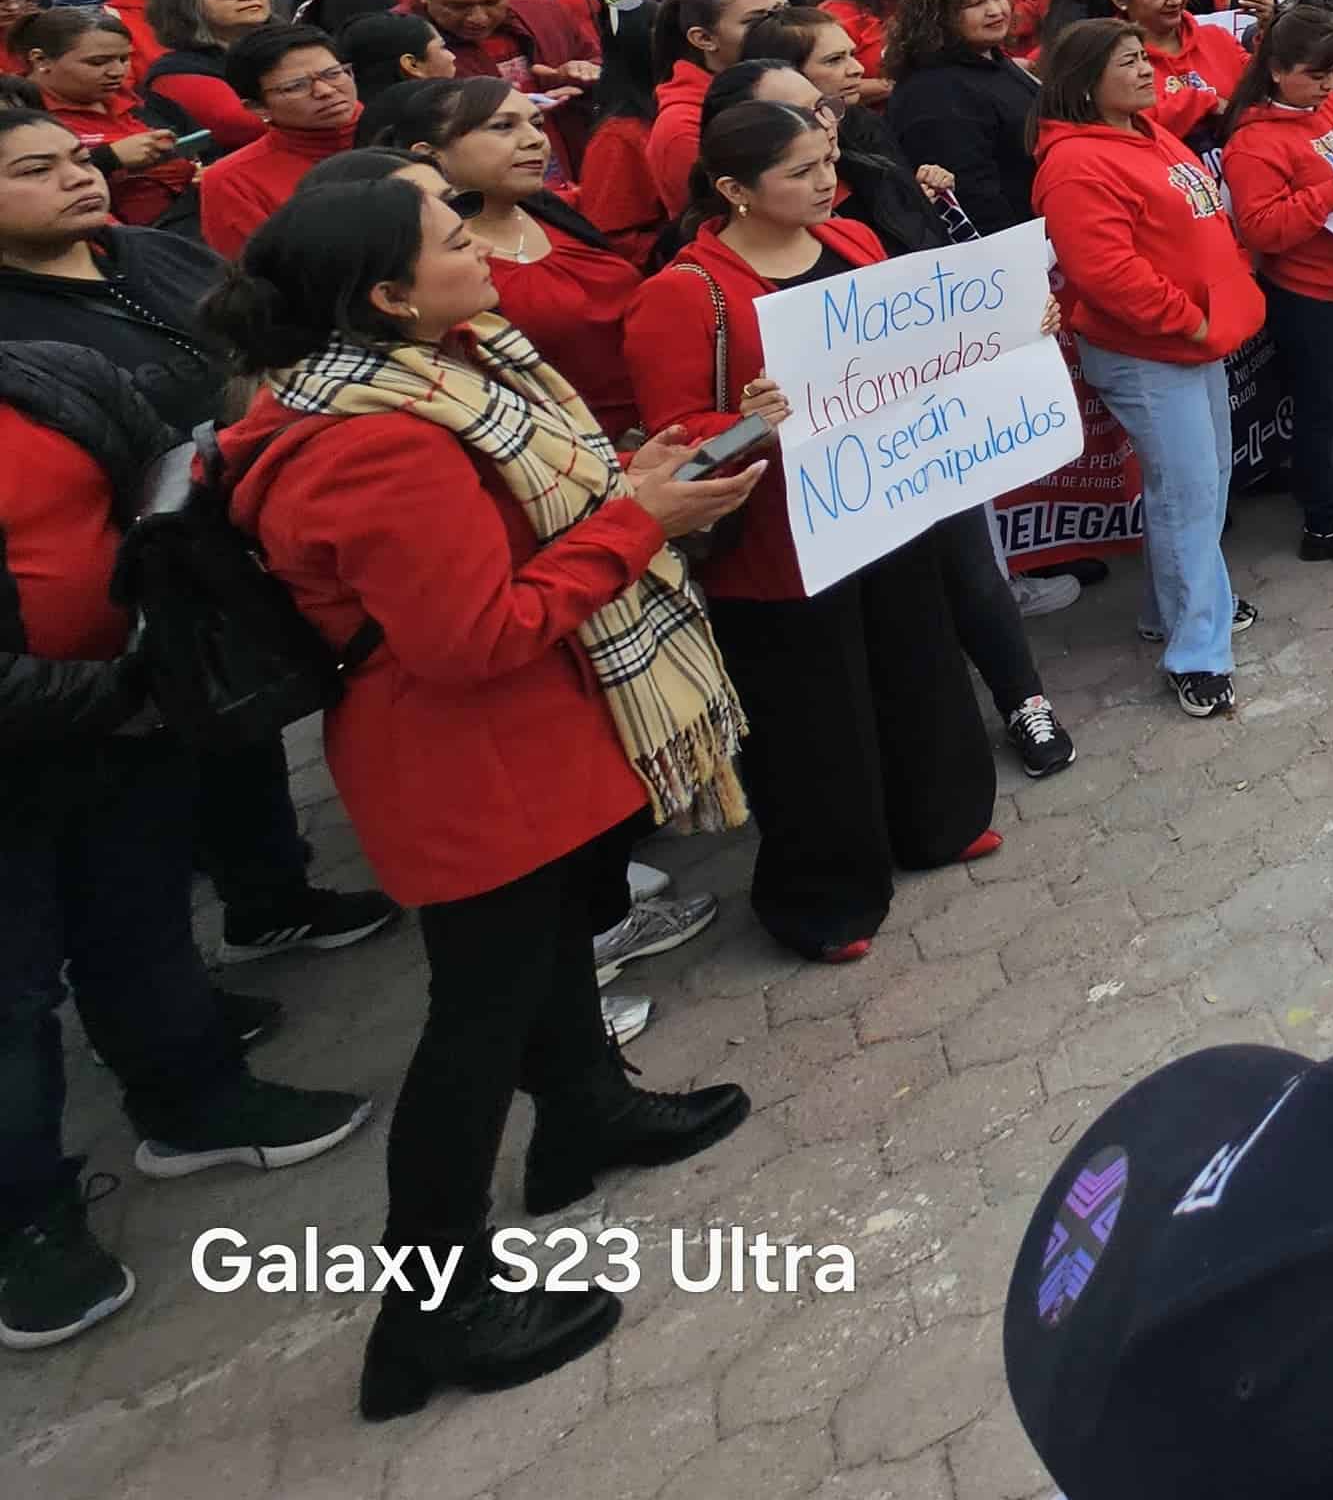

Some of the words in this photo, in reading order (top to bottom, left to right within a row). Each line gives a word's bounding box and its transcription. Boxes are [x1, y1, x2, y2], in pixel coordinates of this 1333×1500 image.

[823, 261, 1006, 351] Maestros
[806, 331, 1002, 437] Informados
[799, 433, 872, 534] NO
[880, 393, 968, 469] serán
[884, 395, 1066, 510] manipulados
[1061, 476, 1078, 488] DE
